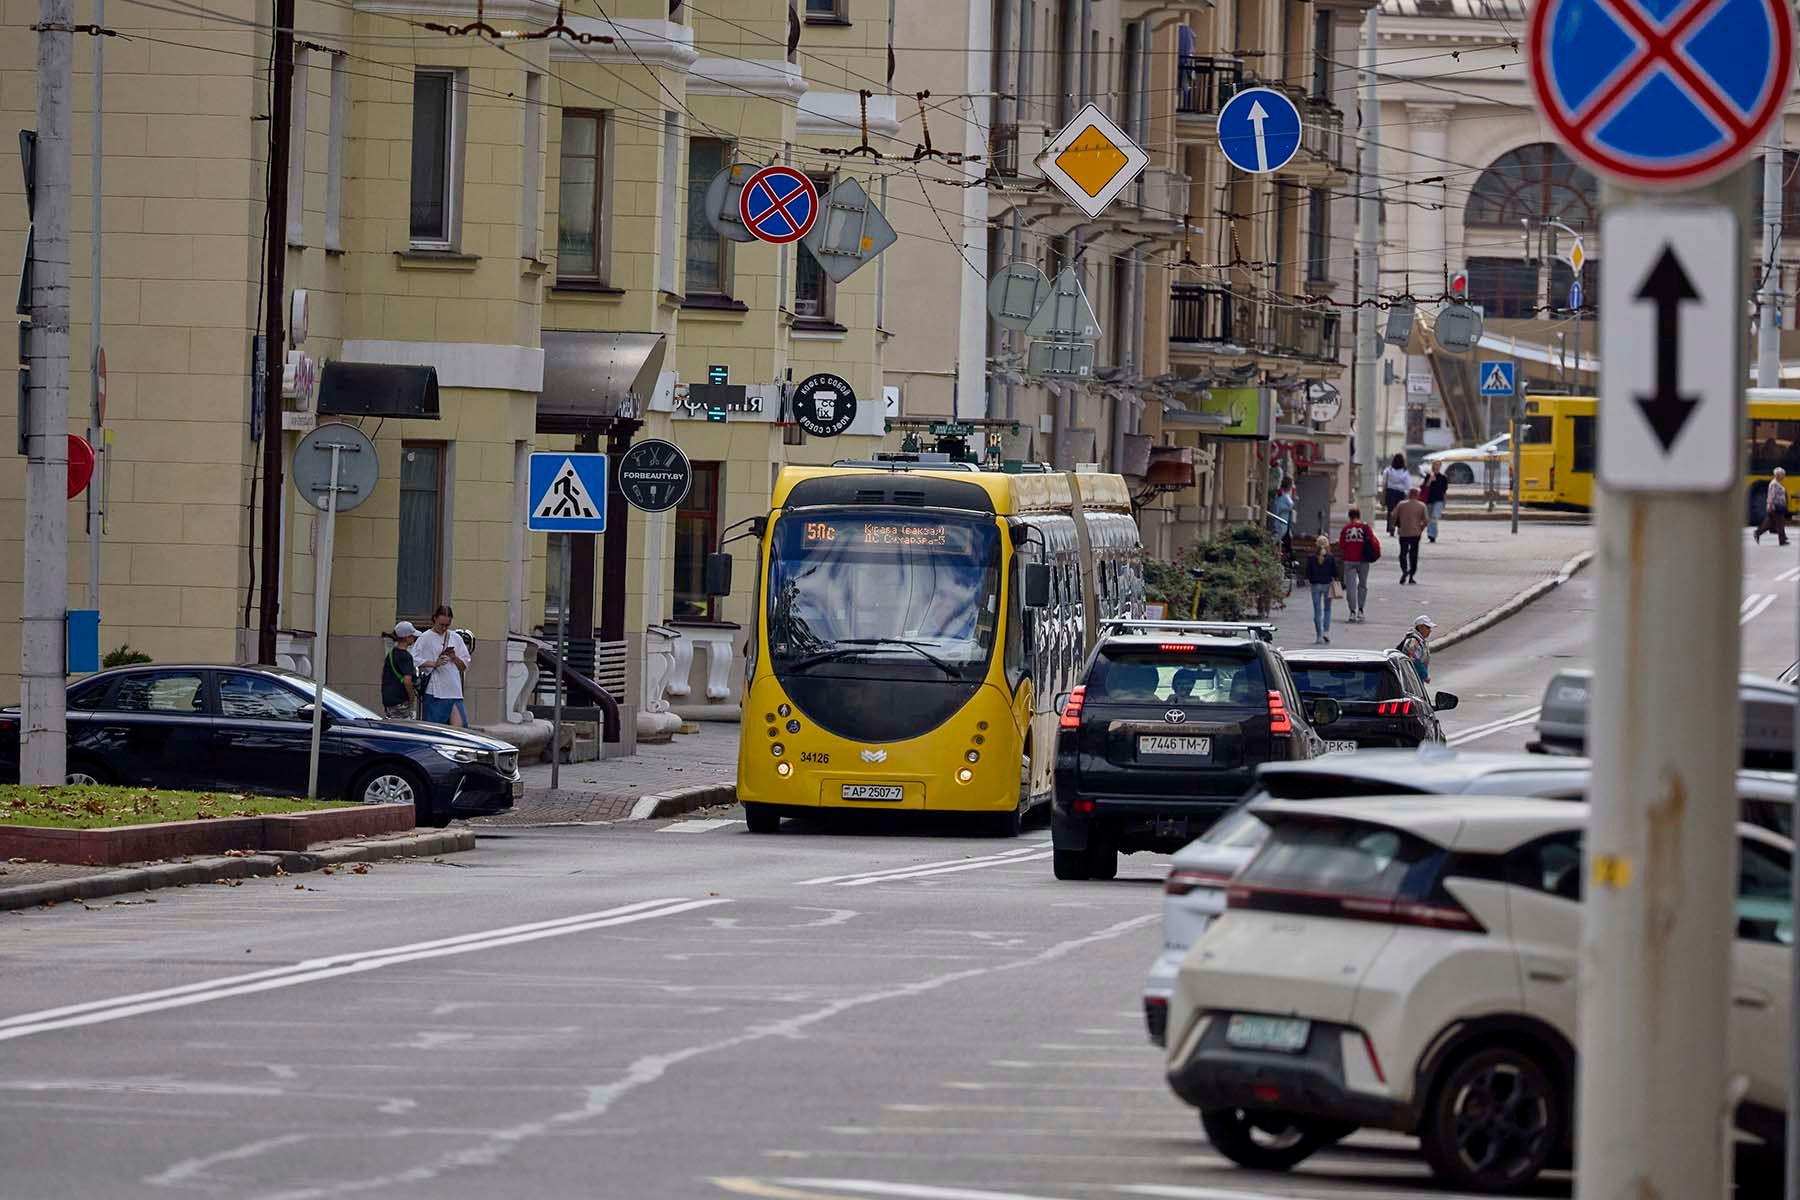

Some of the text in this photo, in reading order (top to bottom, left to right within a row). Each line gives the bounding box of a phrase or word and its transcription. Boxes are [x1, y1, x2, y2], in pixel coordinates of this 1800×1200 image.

[801, 378, 819, 395] КОФЕ
[828, 378, 852, 396] СОБОЙ
[817, 407, 830, 417] fix
[832, 415, 850, 432] КОФЕ
[624, 472, 684, 480] FORBEAUTY.BY
[1150, 737, 1208, 750] 7446 TM-7
[800, 751, 829, 764] 34126
[851, 787, 866, 797] AP
[868, 787, 901, 798] 2507-7
